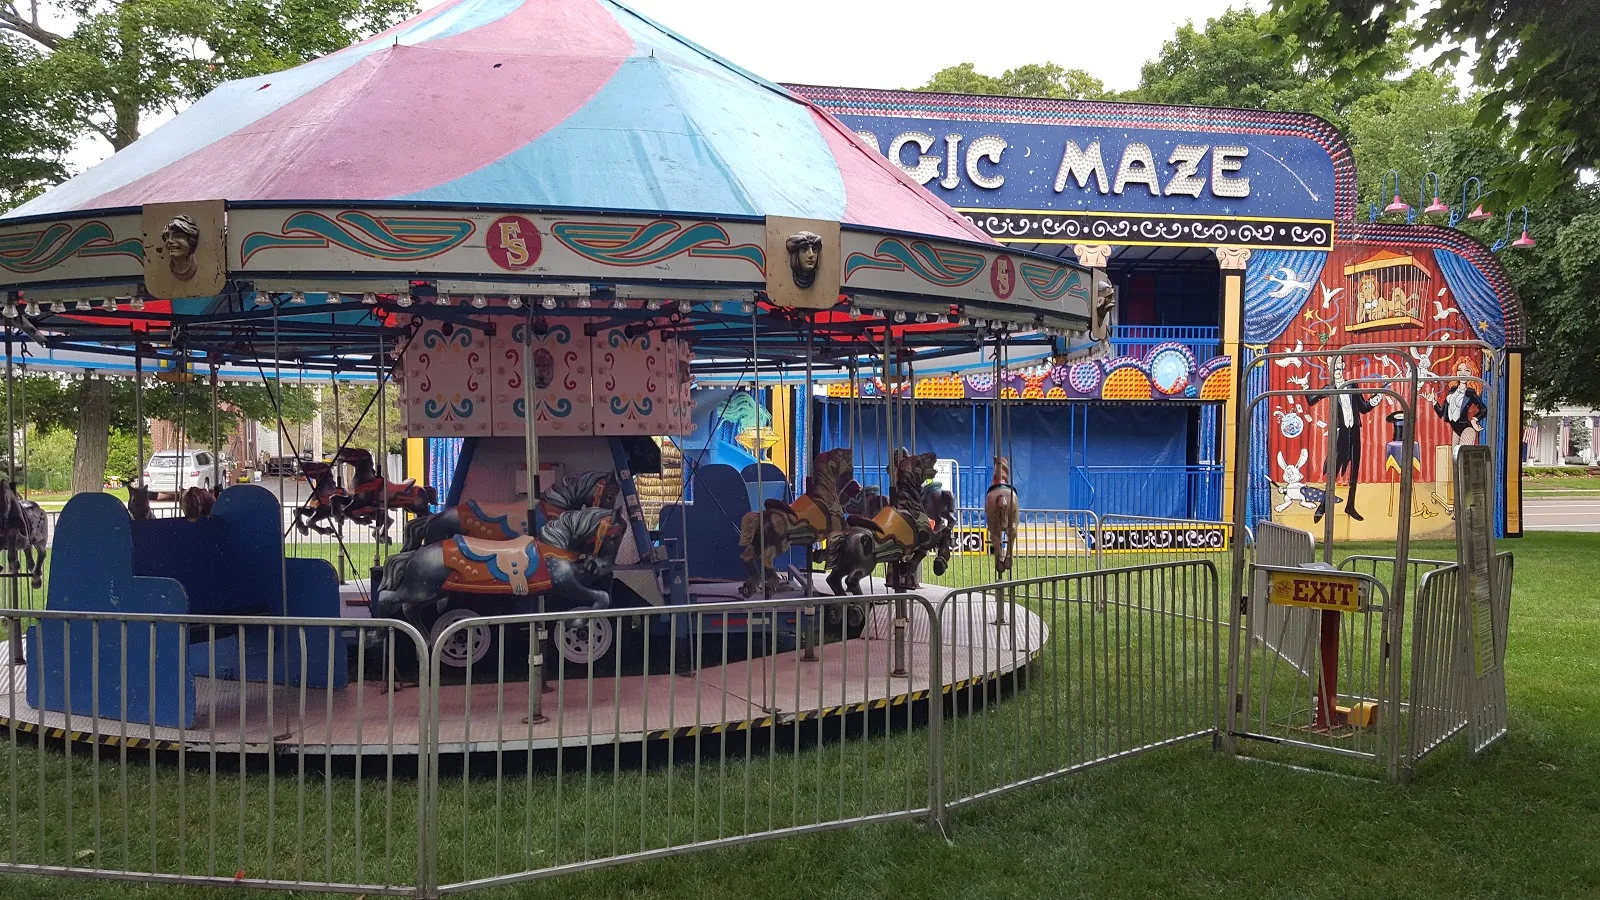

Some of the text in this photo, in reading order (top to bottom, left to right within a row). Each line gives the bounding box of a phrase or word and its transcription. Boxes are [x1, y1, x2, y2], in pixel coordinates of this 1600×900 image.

[855, 129, 1251, 198] GIC MAZE
[1292, 579, 1354, 606] EXIT
